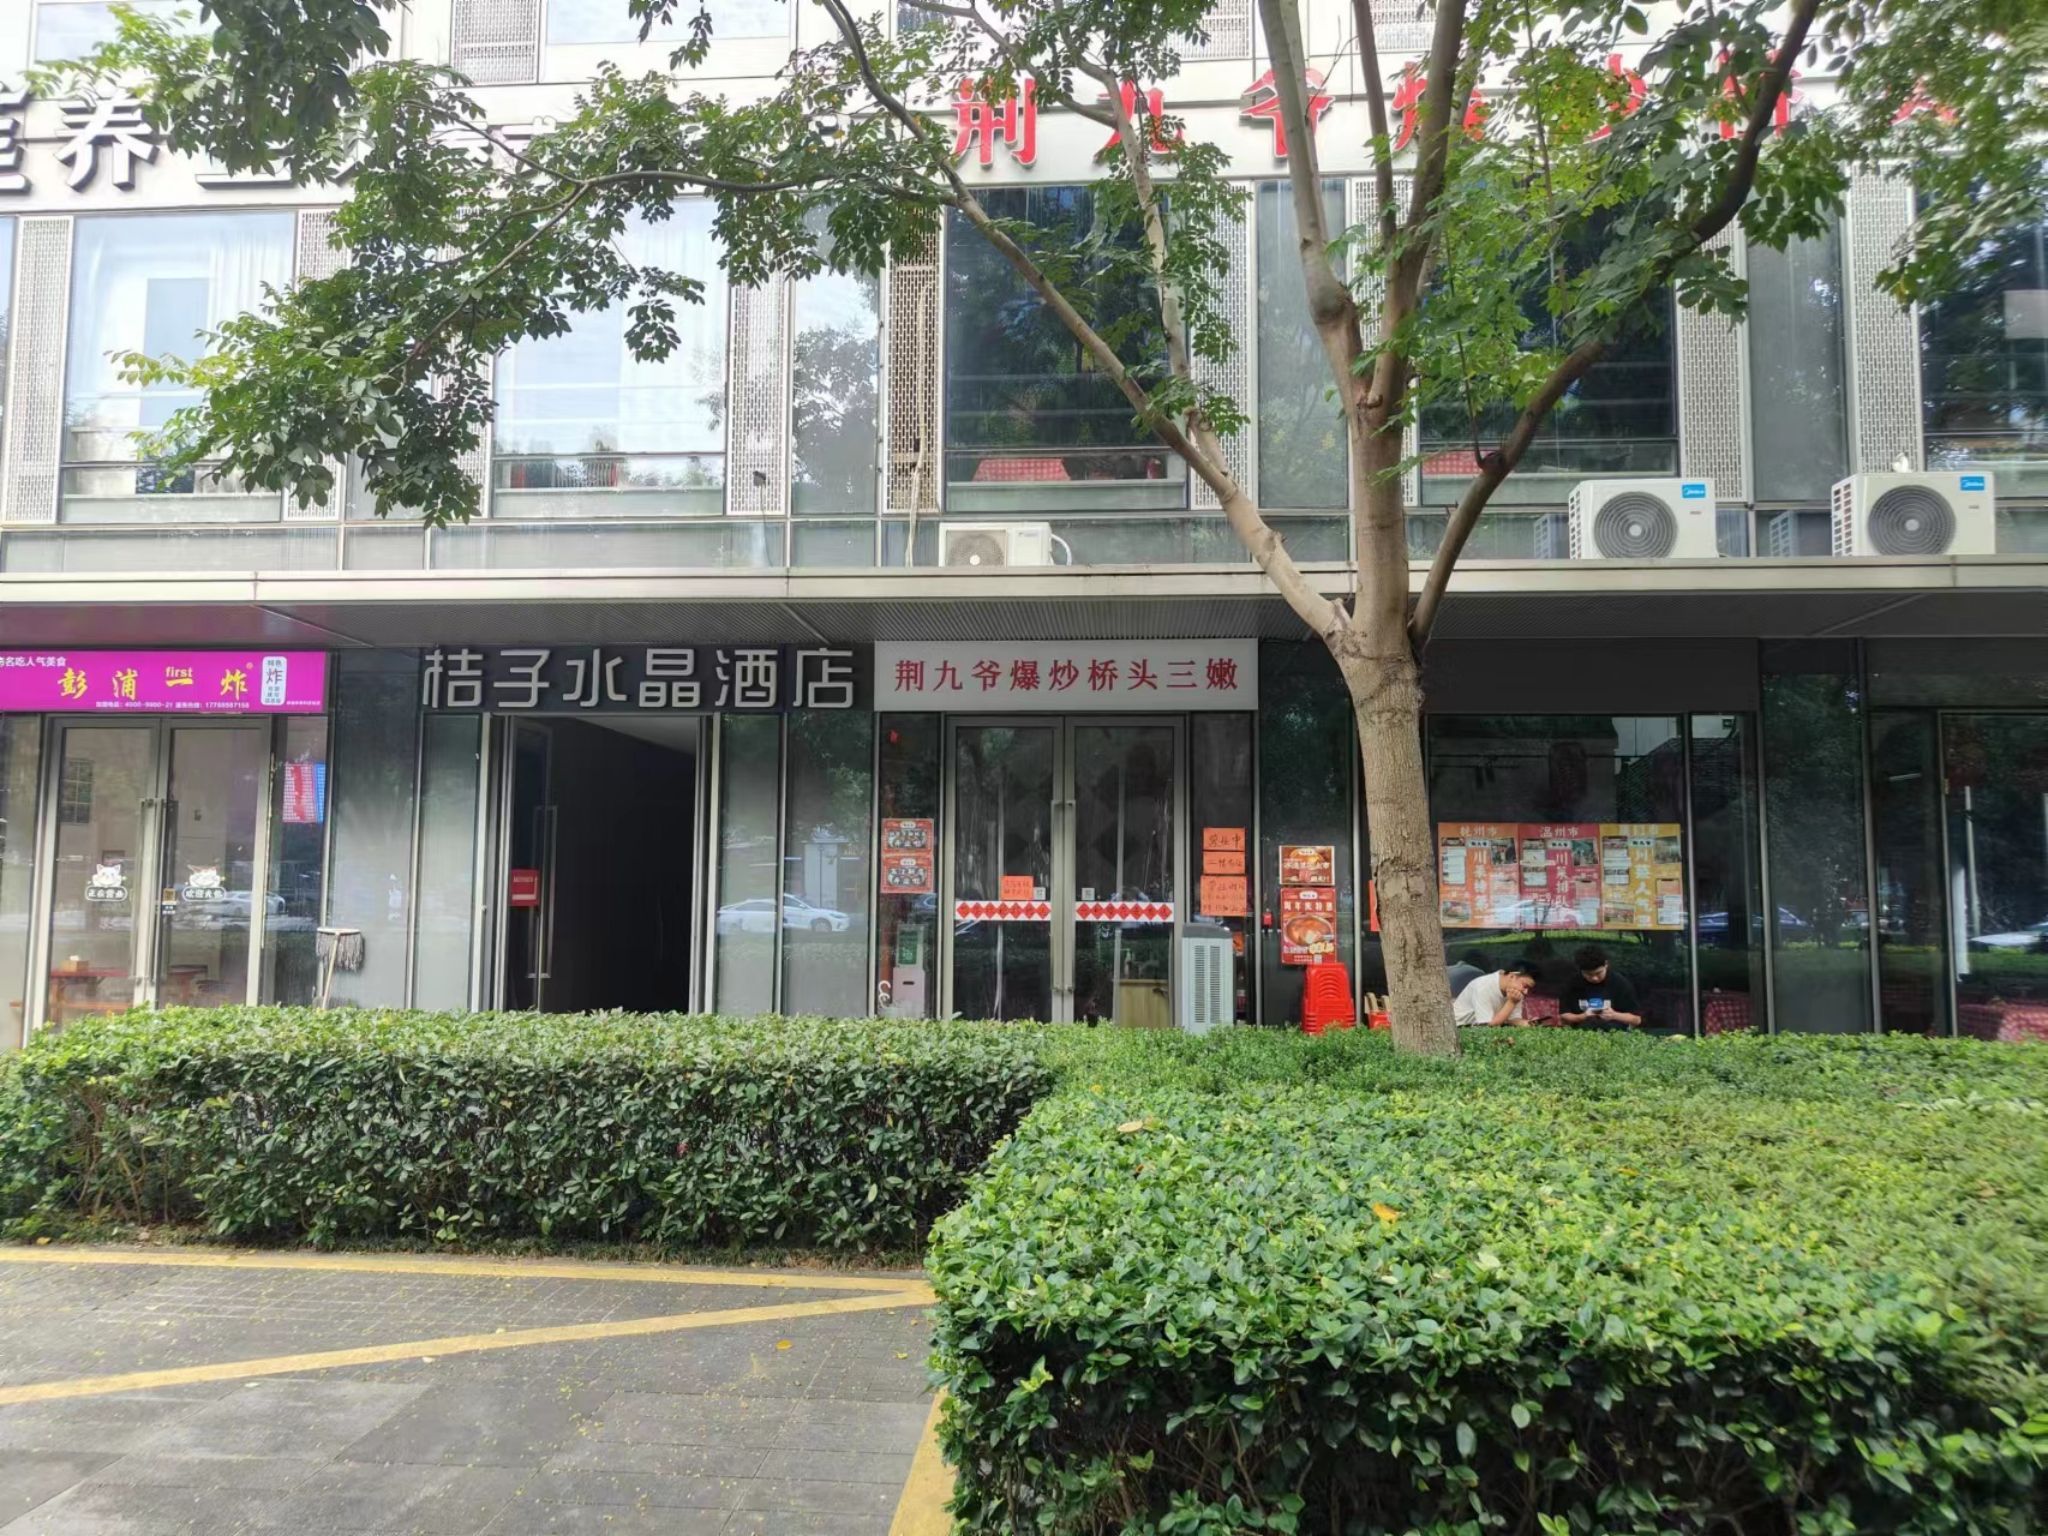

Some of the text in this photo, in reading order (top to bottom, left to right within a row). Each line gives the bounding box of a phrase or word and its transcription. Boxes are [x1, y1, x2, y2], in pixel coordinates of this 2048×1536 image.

[165, 666, 194, 679] first
[422, 647, 855, 710] 桔子水晶酒店
[894, 656, 1240, 693] 荆九爷爆炒桥头三嫩
